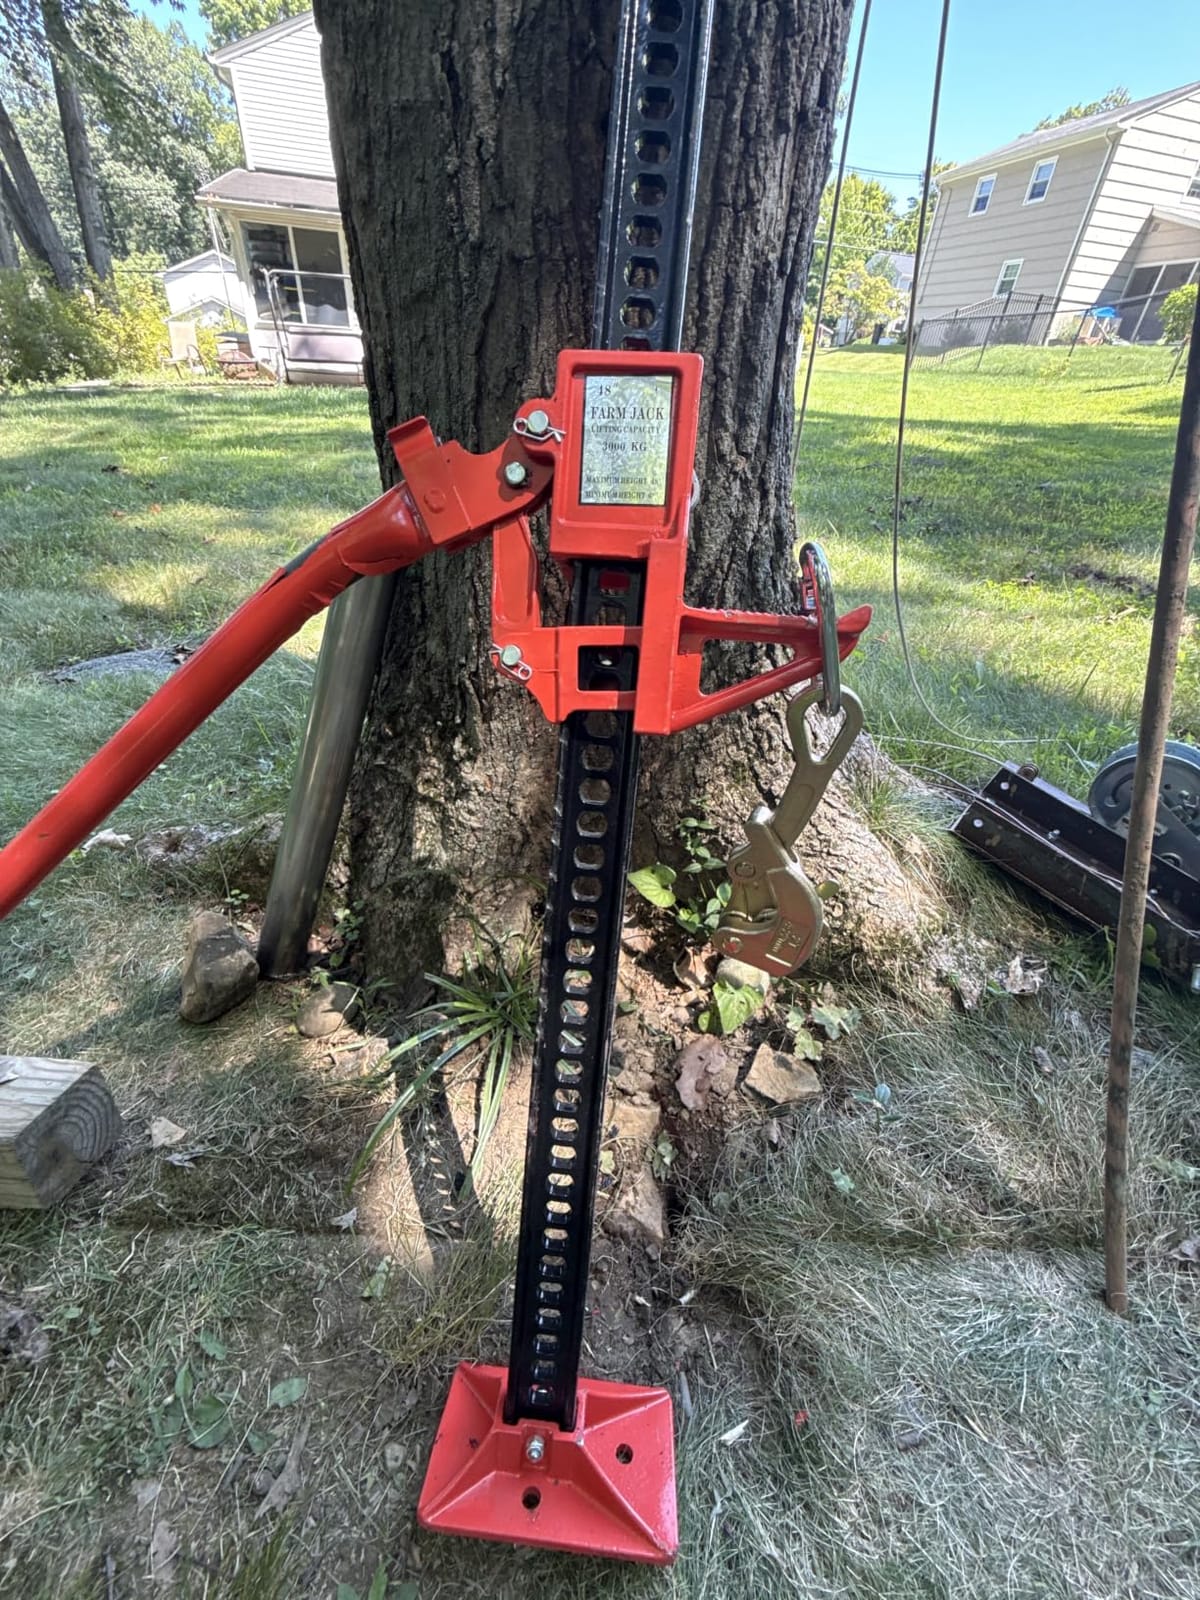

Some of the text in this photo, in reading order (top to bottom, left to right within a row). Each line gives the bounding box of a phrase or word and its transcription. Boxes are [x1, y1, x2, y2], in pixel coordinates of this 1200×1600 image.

[591, 406, 664, 420] FARM JACK
[623, 426, 660, 434] CAPACITY
[602, 441, 647, 451] 3000 KG
[620, 477, 647, 485] HEIGHT
[618, 491, 645, 499] HEIGHT
